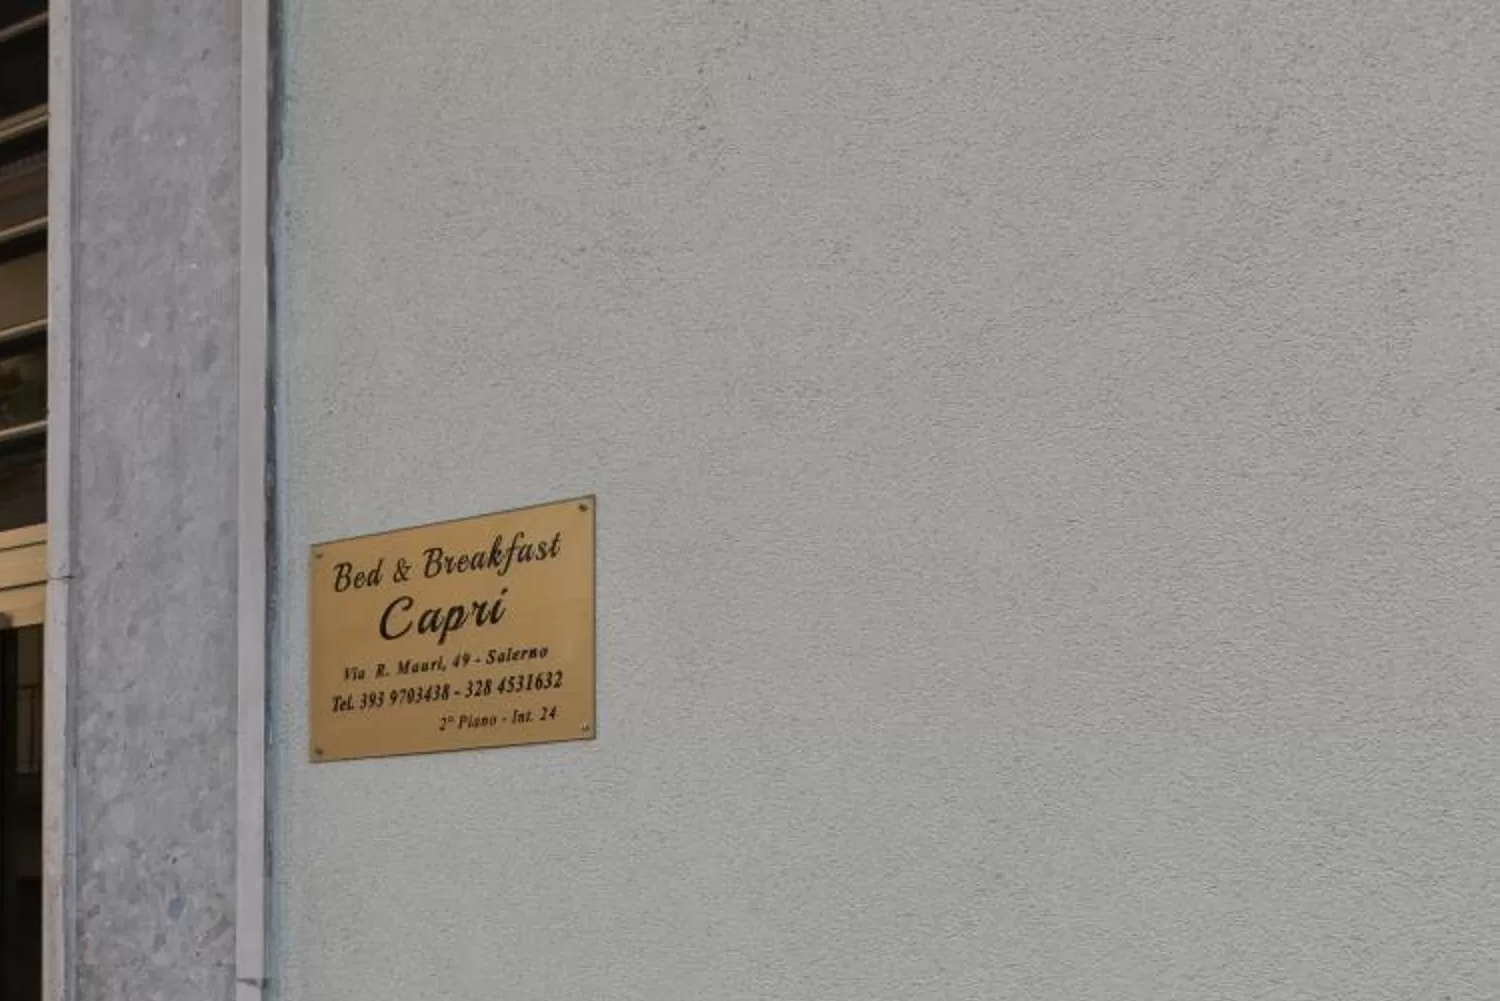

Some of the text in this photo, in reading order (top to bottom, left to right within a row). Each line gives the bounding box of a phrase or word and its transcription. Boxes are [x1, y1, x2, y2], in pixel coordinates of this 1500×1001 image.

[332, 531, 561, 593] Bed & Breakfast
[378, 587, 509, 646] Capri
[343, 666, 366, 682] Via
[452, 651, 471, 669] 49
[486, 646, 549, 665] Salerno
[332, 695, 355, 713] Tel.
[359, 691, 385, 711] 393
[388, 683, 451, 705] 9703438
[464, 678, 493, 699] 328
[496, 669, 564, 694] 4531632
[457, 714, 498, 730] Piano
[539, 705, 558, 721] 24
